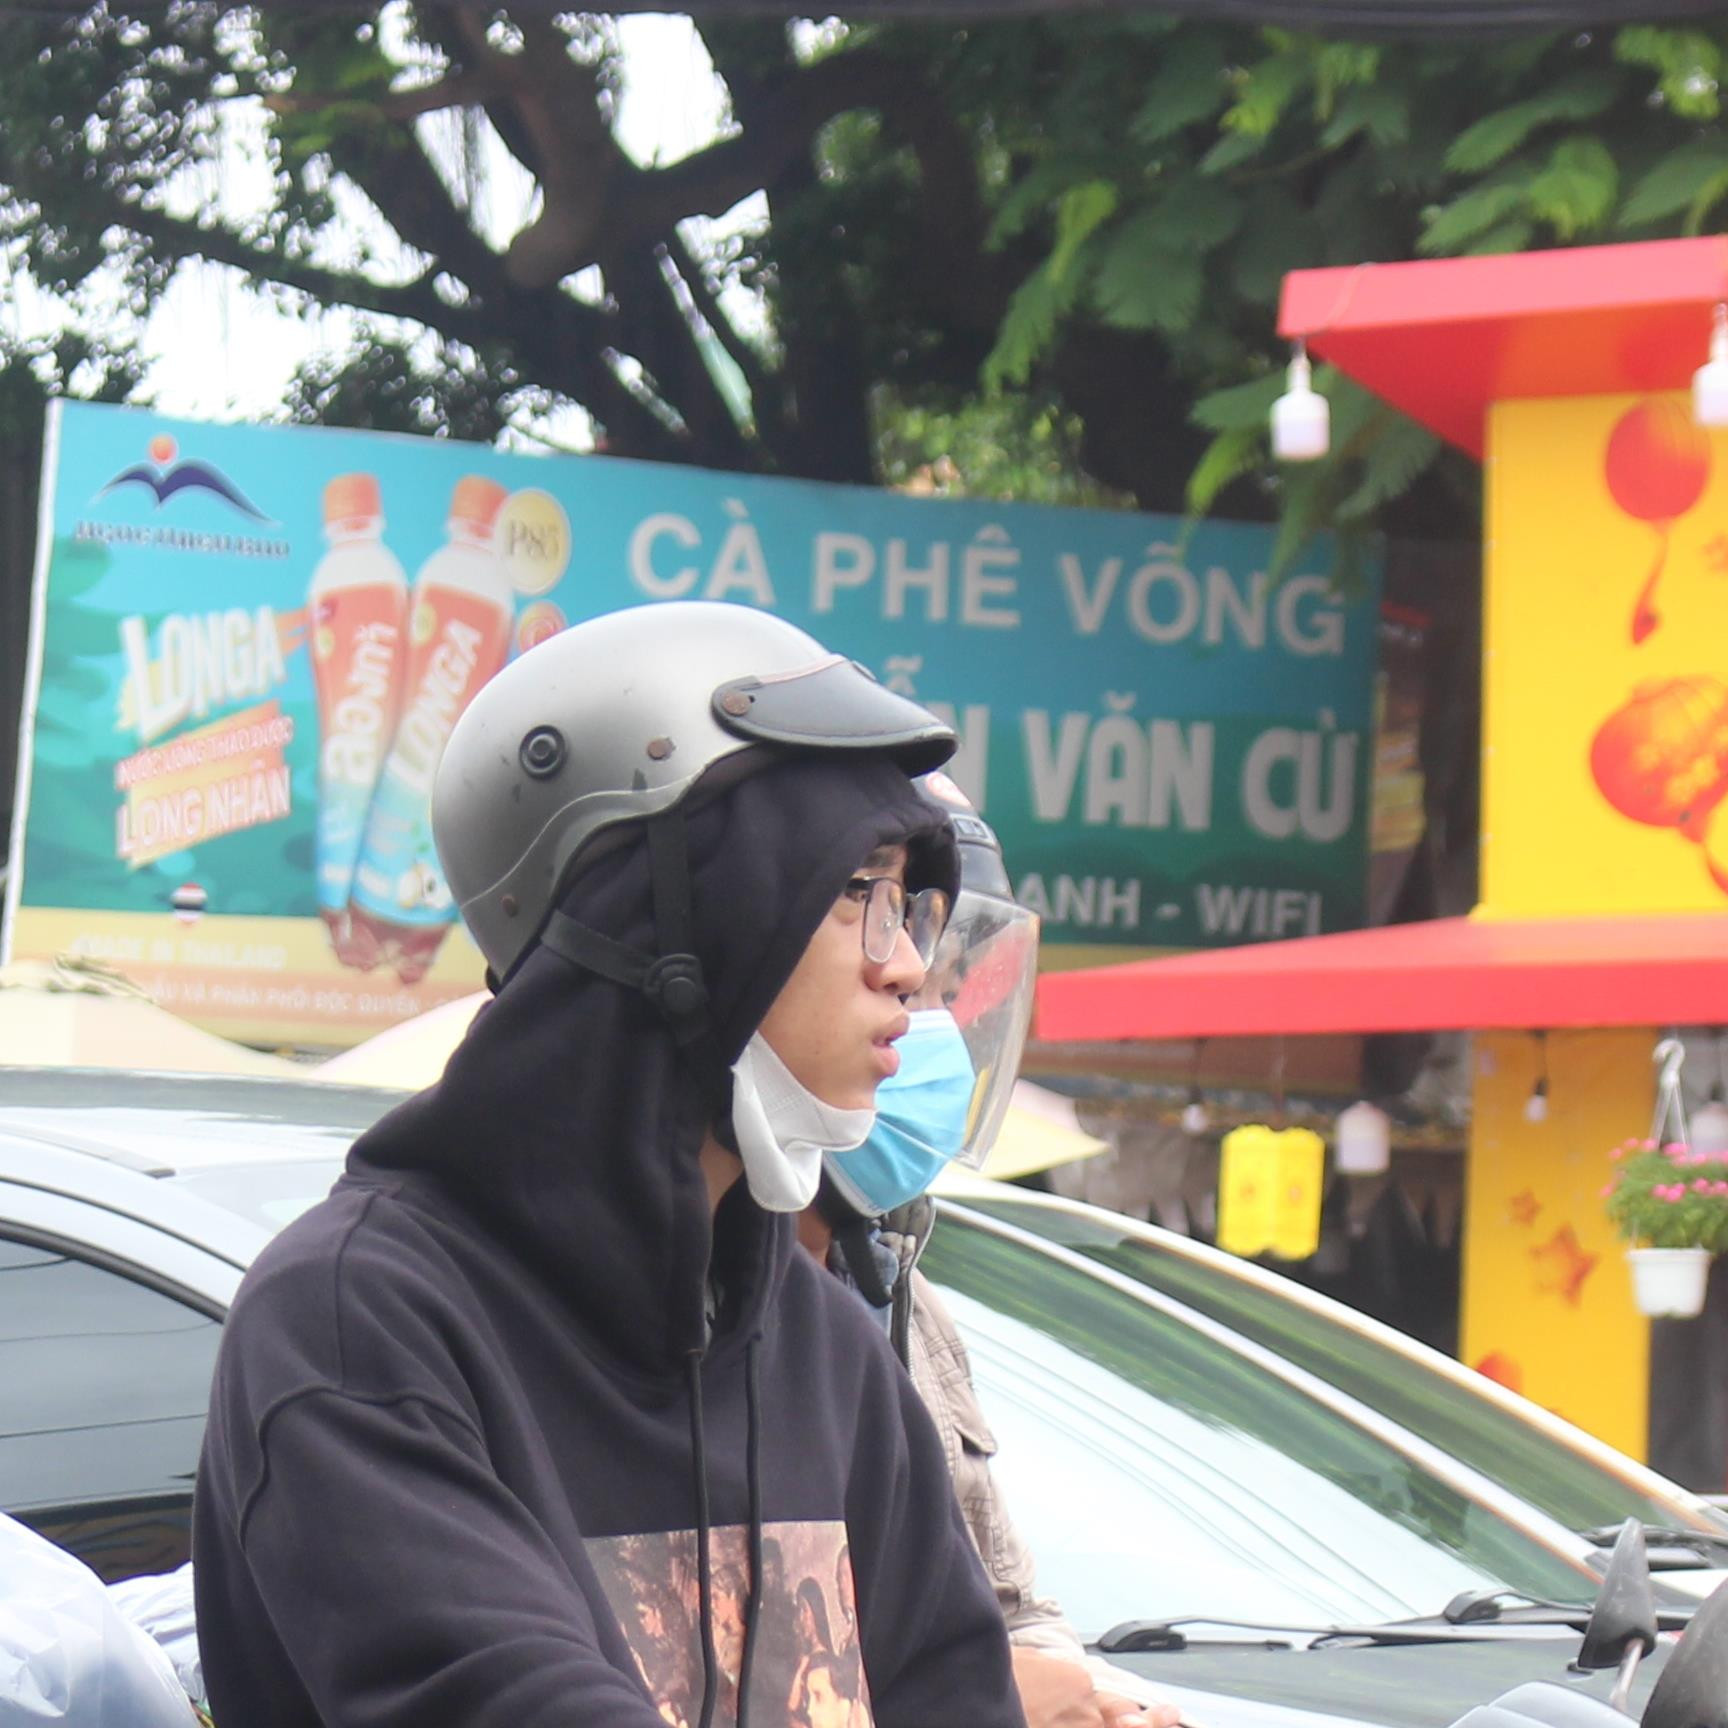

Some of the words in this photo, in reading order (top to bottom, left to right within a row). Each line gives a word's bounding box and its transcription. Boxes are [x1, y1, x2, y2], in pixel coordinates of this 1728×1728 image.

[626, 497, 775, 603] CÀ
[812, 525, 1022, 629] PHÊ
[1059, 541, 1346, 656] VÕNG
[120, 605, 287, 742] LONGA
[386, 618, 484, 793] LONGA
[116, 787, 204, 858] LONG
[1023, 691, 1214, 832] VĂN
[1195, 883, 1323, 937] WIFI
